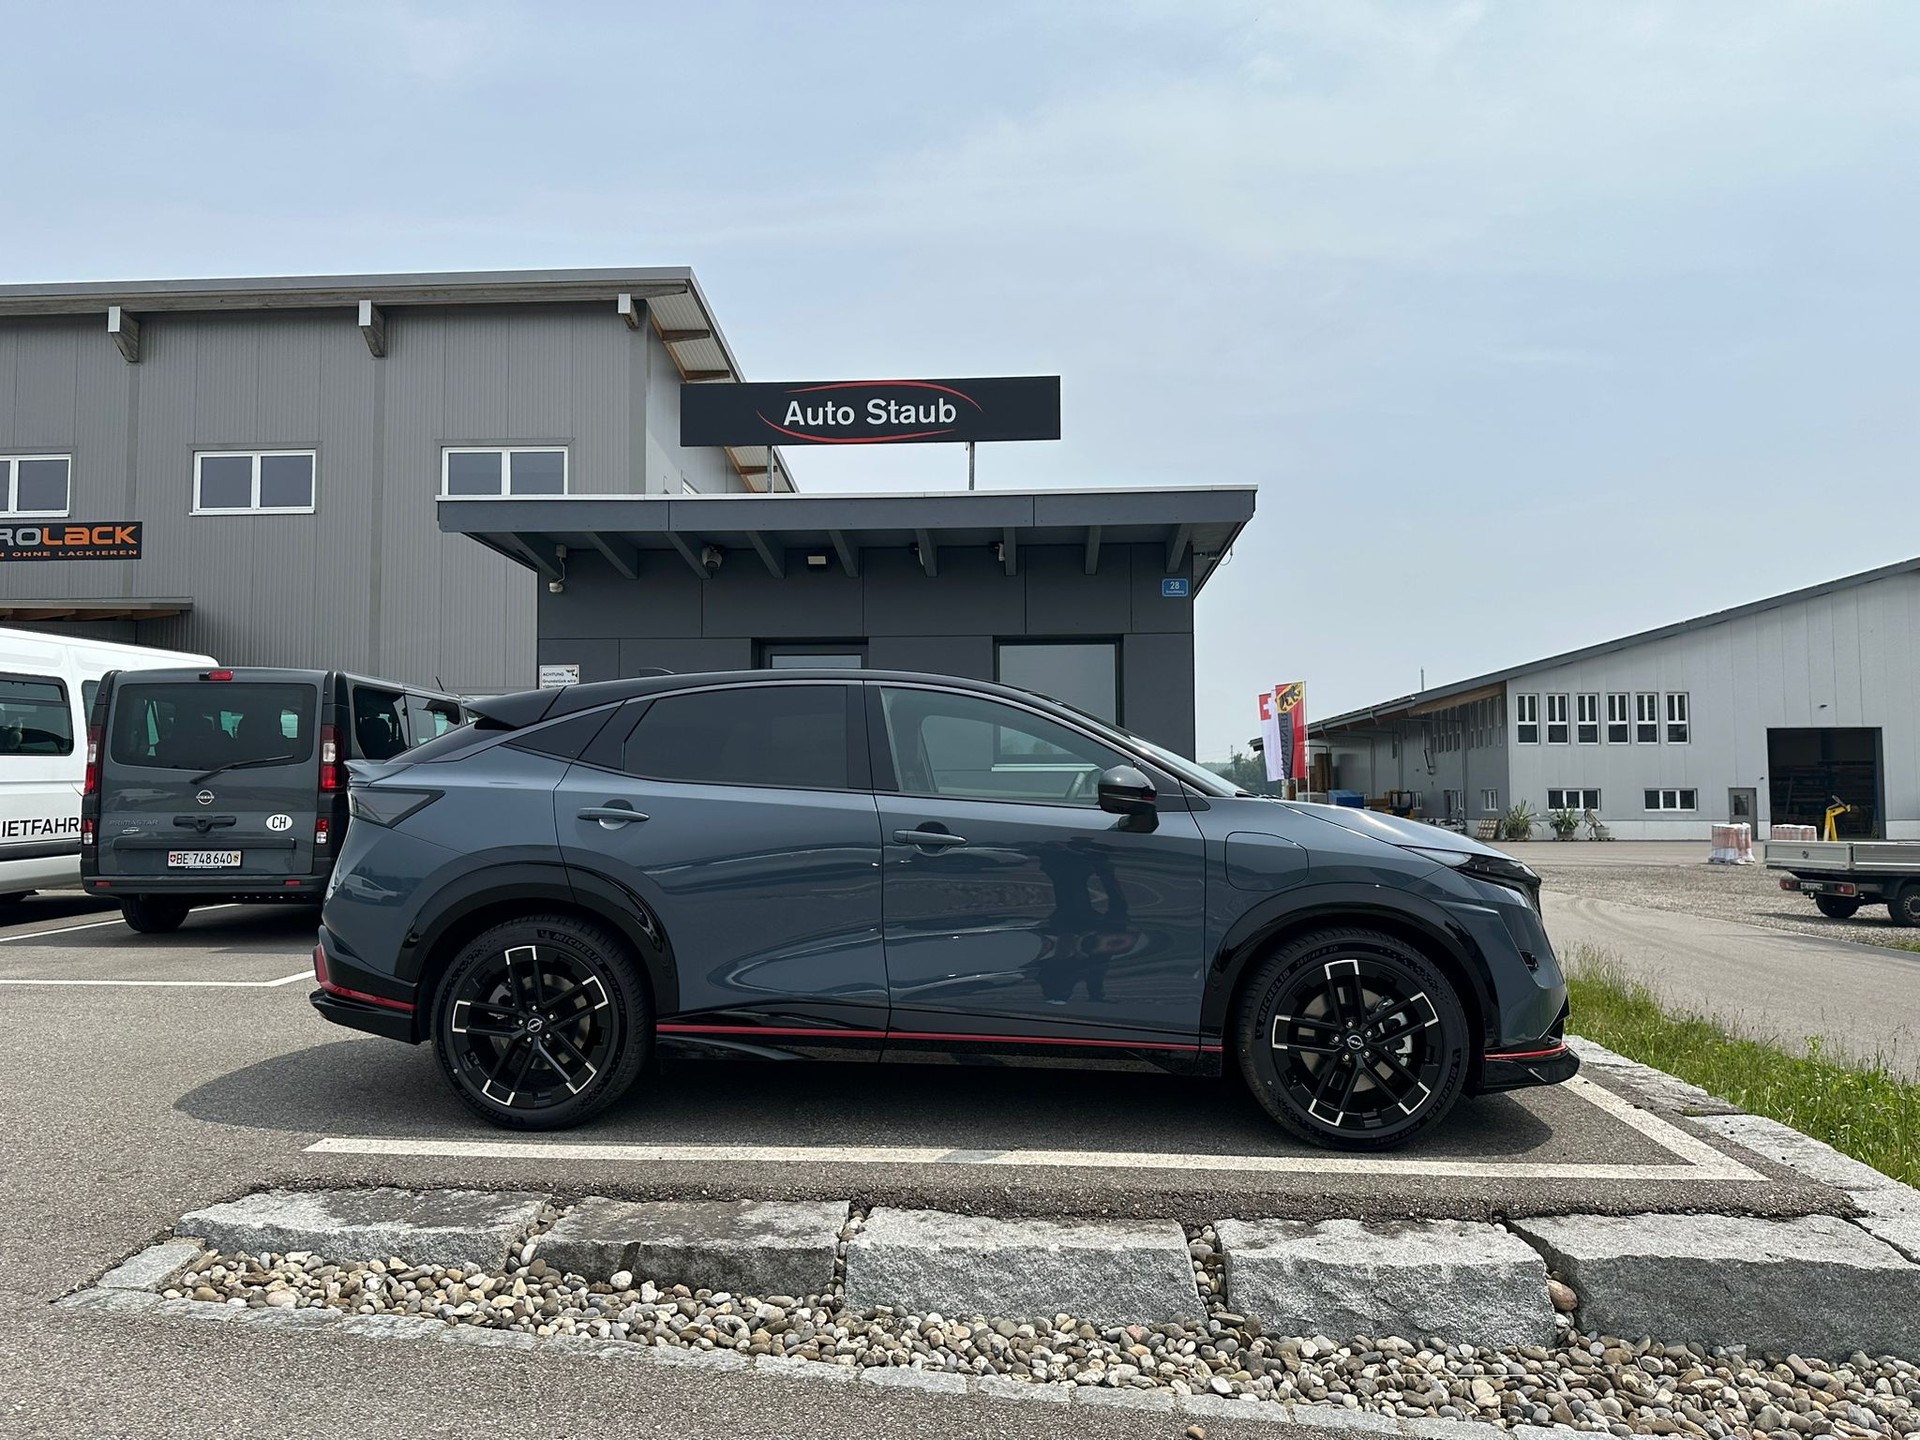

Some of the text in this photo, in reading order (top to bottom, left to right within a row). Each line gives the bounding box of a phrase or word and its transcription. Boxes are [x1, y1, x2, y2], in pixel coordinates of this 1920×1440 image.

[783, 397, 957, 426] Auto Staub
[58, 549, 138, 557] LACKIEREN
[1170, 581, 1180, 590] 28
[2, 817, 81, 837] IETFAHR
[272, 816, 287, 829] CH
[176, 853, 232, 864] BE 748640
[552, 933, 604, 966] MICHELIN
[1259, 969, 1291, 1022] MICHELIN
